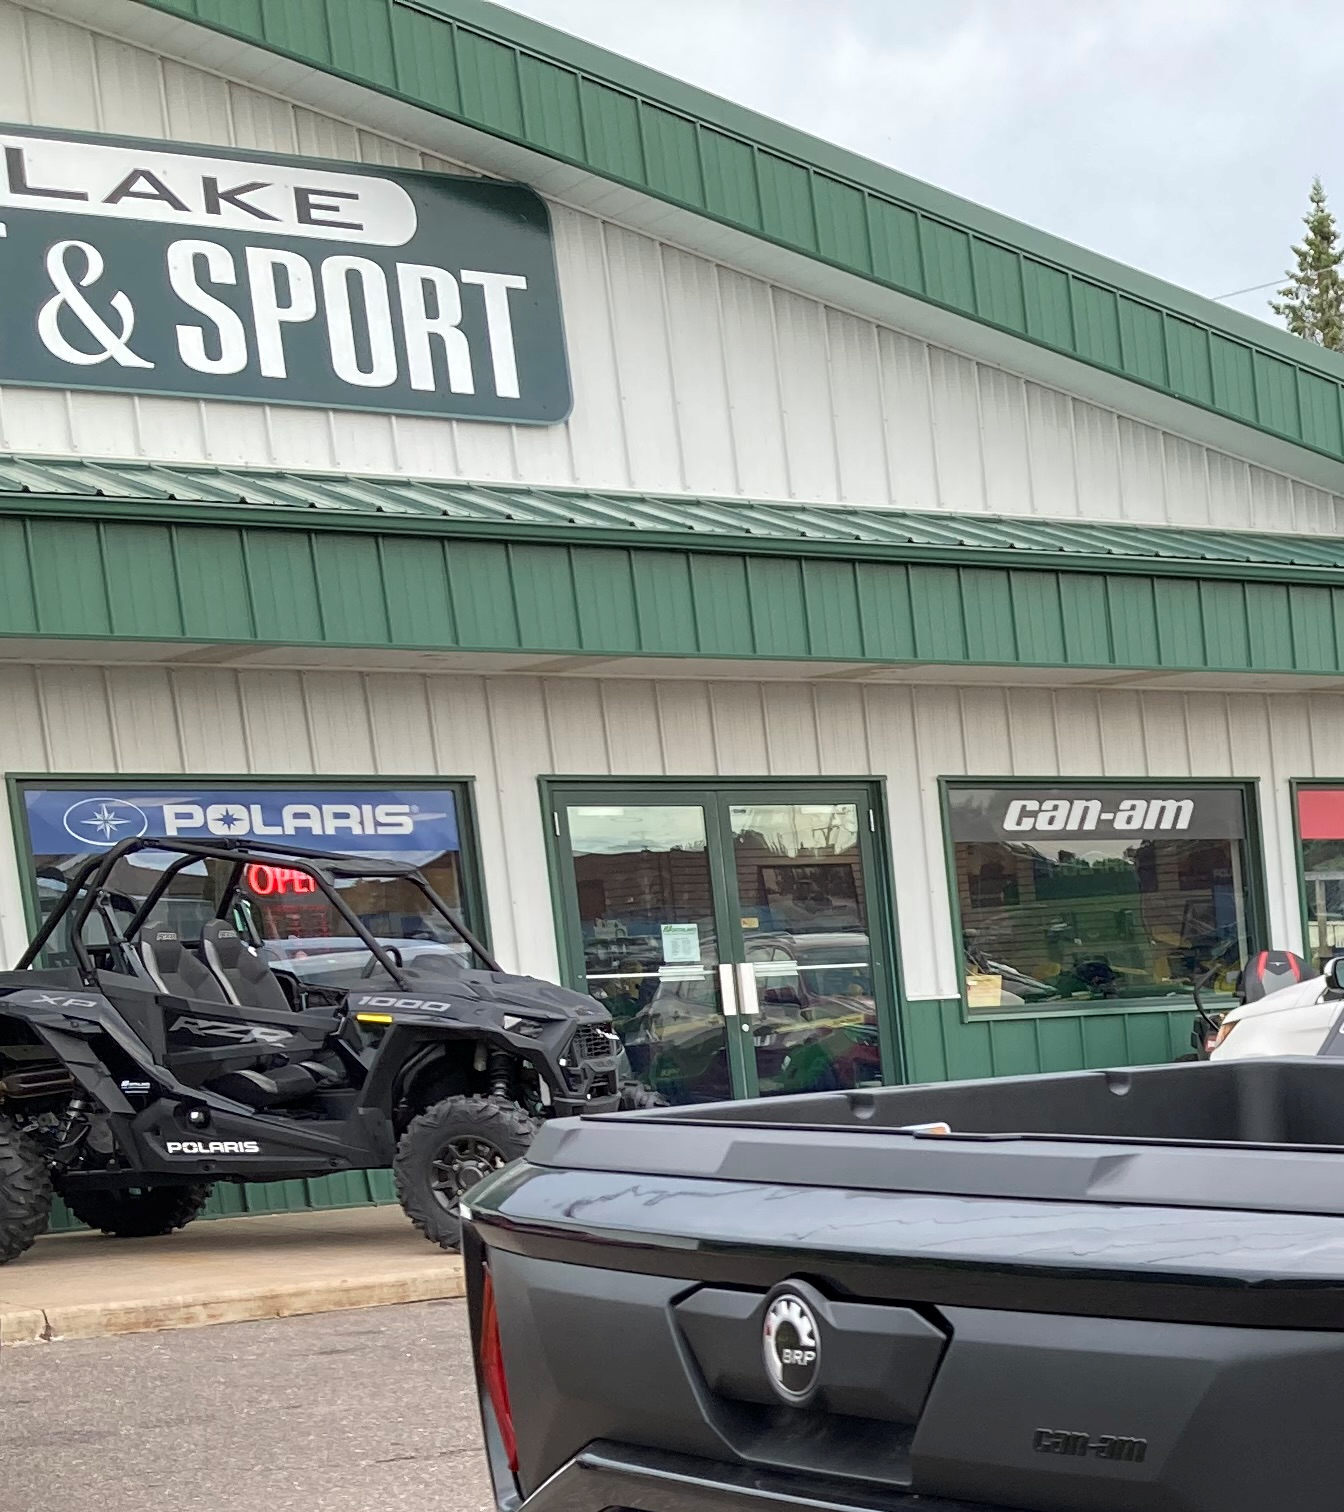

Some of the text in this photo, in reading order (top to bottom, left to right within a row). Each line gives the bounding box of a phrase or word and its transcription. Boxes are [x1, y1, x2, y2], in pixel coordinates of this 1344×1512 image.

[4, 146, 364, 231] LAKE
[38, 239, 528, 398] & SPORT
[163, 804, 415, 836] POLARIS
[1003, 799, 1195, 831] can-am
[32, 994, 98, 1008] XP
[358, 996, 451, 1012] 1000
[166, 1141, 260, 1154] POLARIS
[782, 1348, 817, 1366] BRP
[1033, 1427, 1148, 1463] can-am
